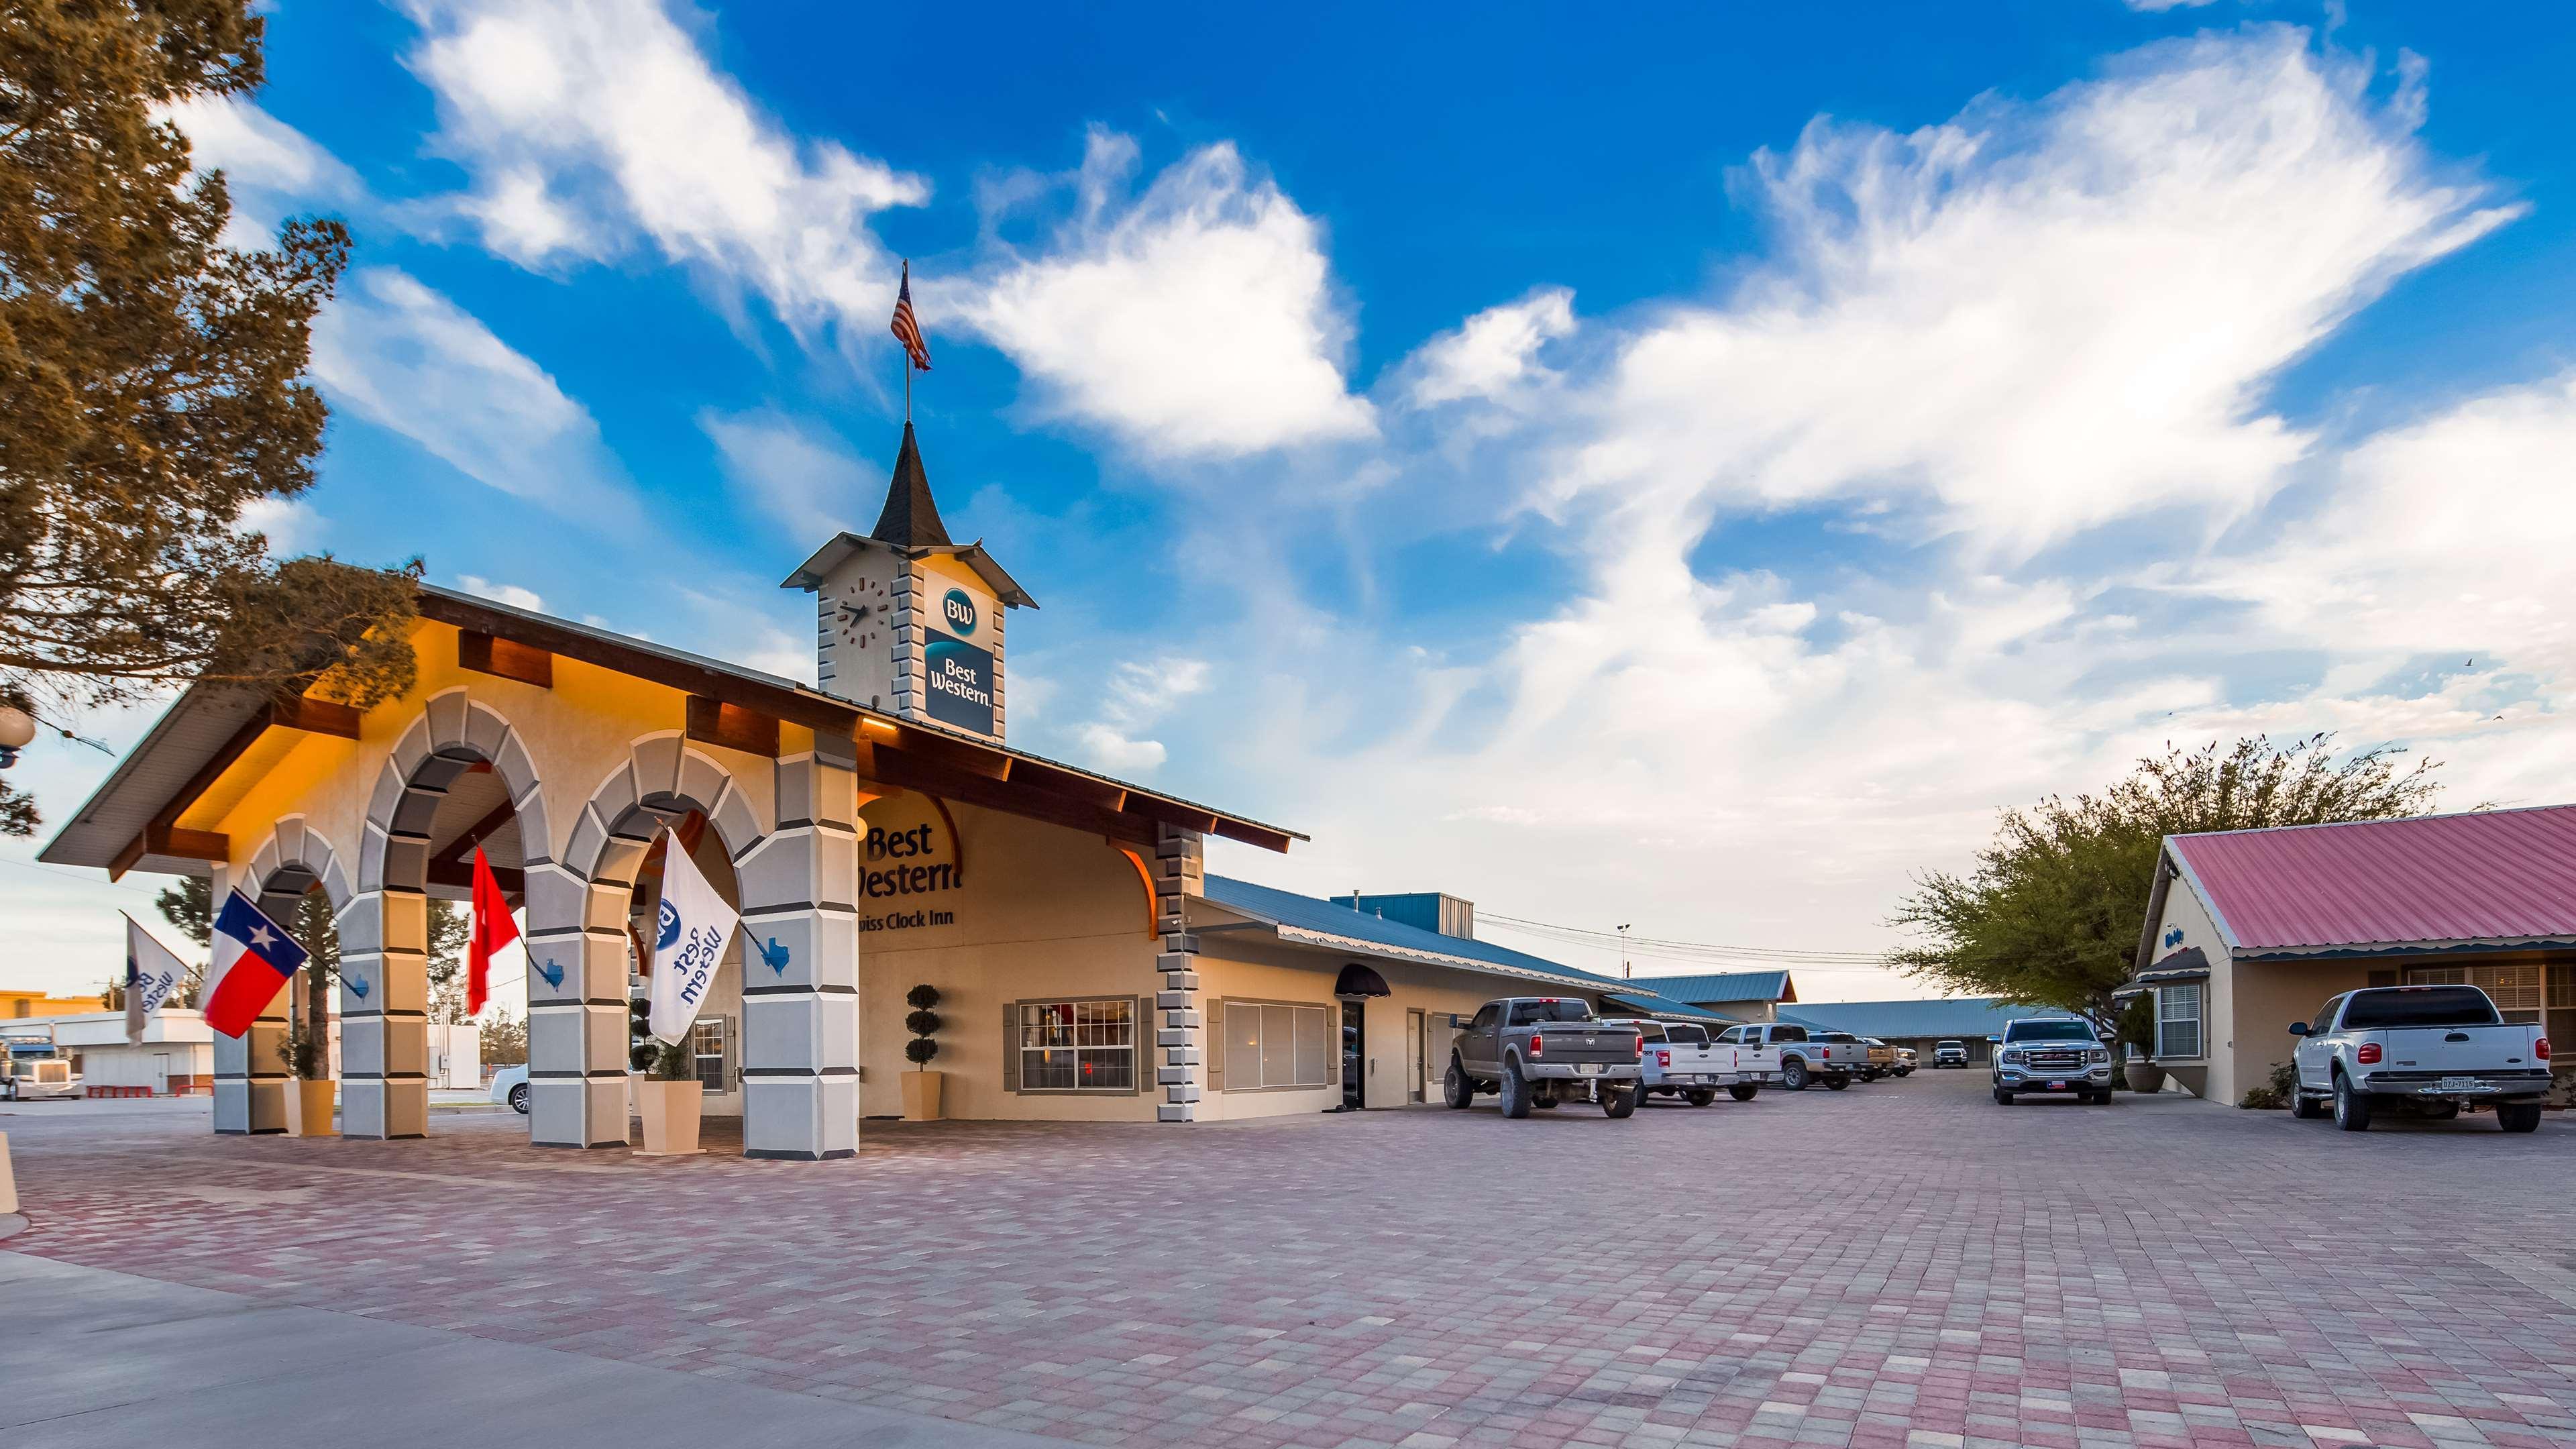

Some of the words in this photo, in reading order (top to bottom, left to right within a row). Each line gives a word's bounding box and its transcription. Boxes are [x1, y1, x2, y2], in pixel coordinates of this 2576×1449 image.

[947, 599, 973, 625] BW
[945, 657, 977, 685] Best
[867, 823, 933, 861] Best
[859, 915, 883, 932] wiss
[886, 910, 925, 930] Clock
[929, 910, 953, 926] Inn
